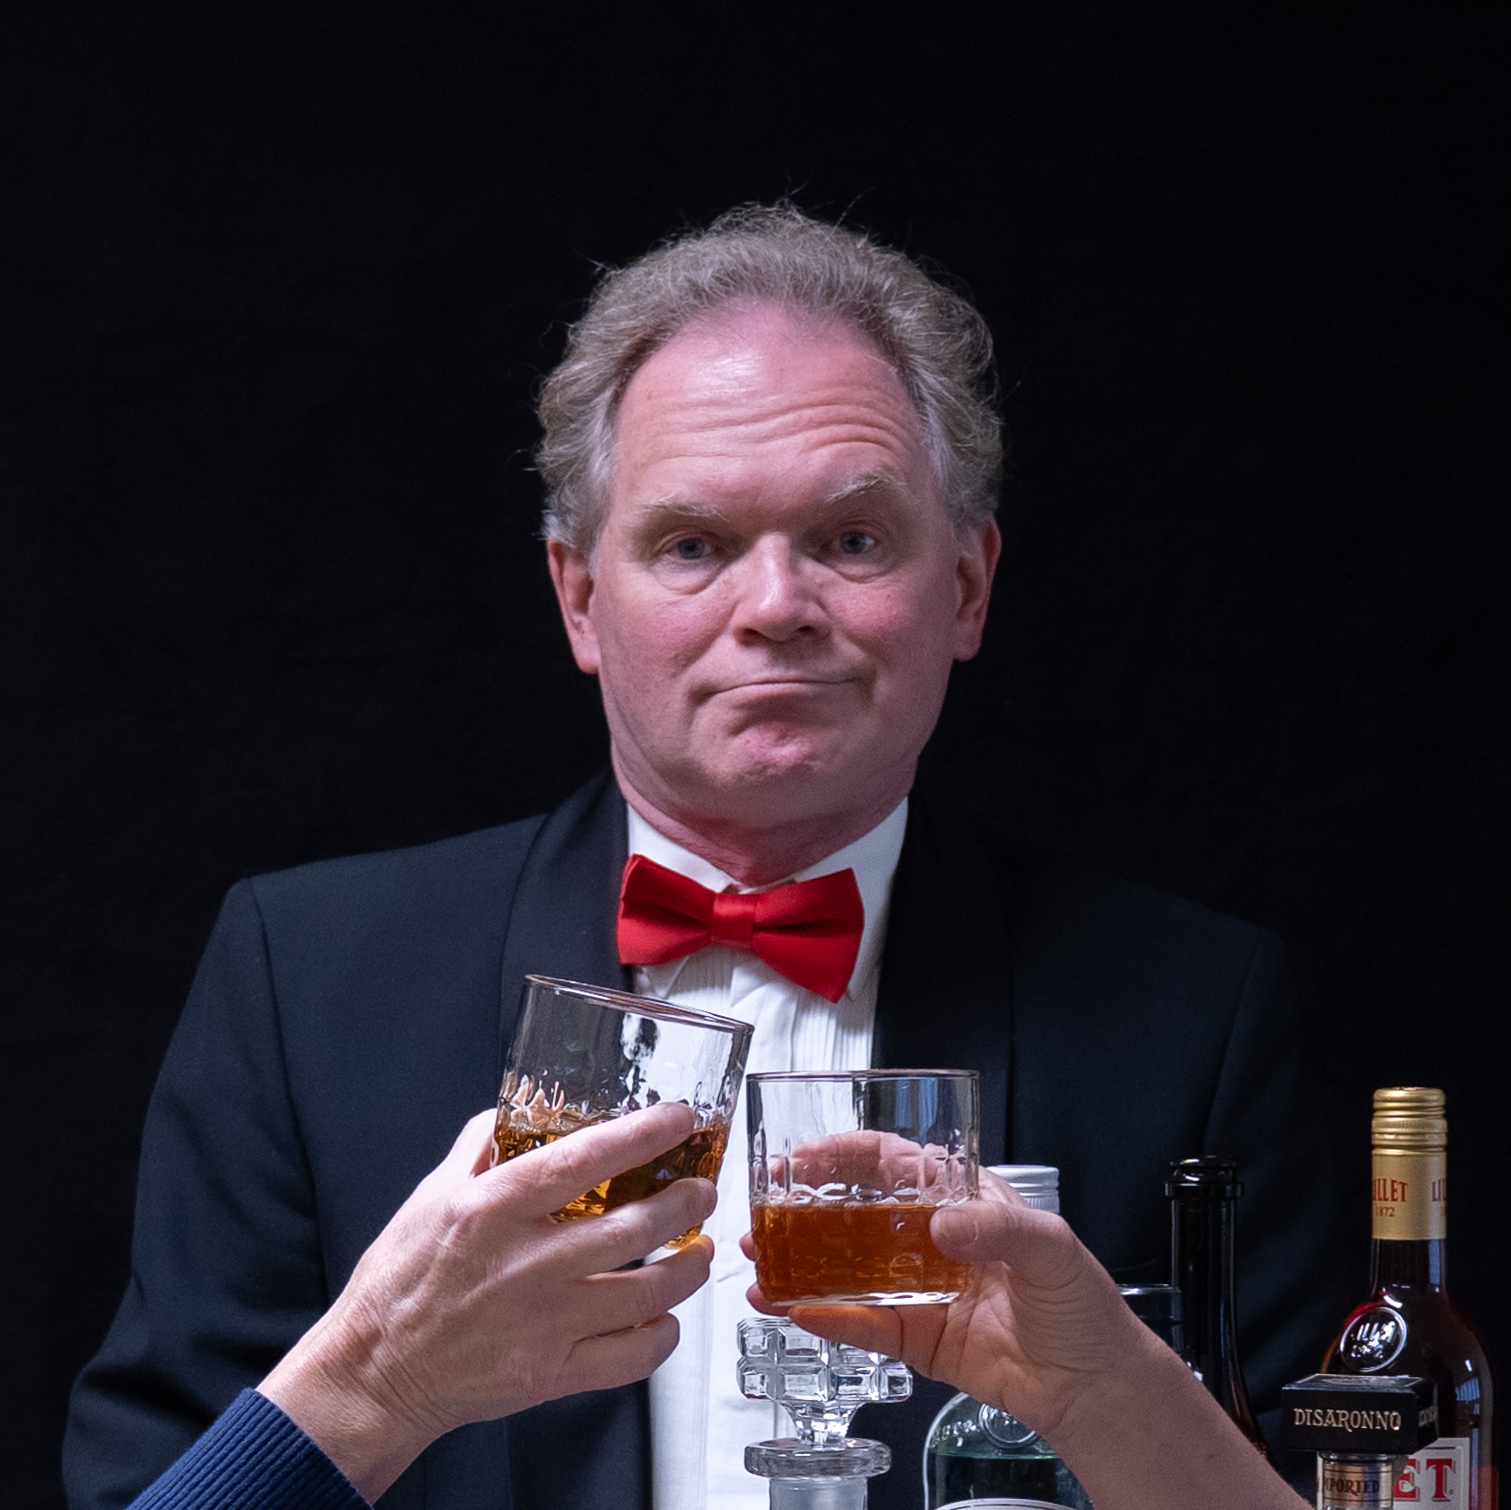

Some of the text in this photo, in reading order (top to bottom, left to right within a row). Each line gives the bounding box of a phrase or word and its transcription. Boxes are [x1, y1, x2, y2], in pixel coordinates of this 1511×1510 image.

[1372, 1178, 1407, 1202] ILLET
[1375, 1206, 1395, 1217] 1872
[1294, 1408, 1402, 1432] DISARONNO
[1393, 1458, 1454, 1502] ET
